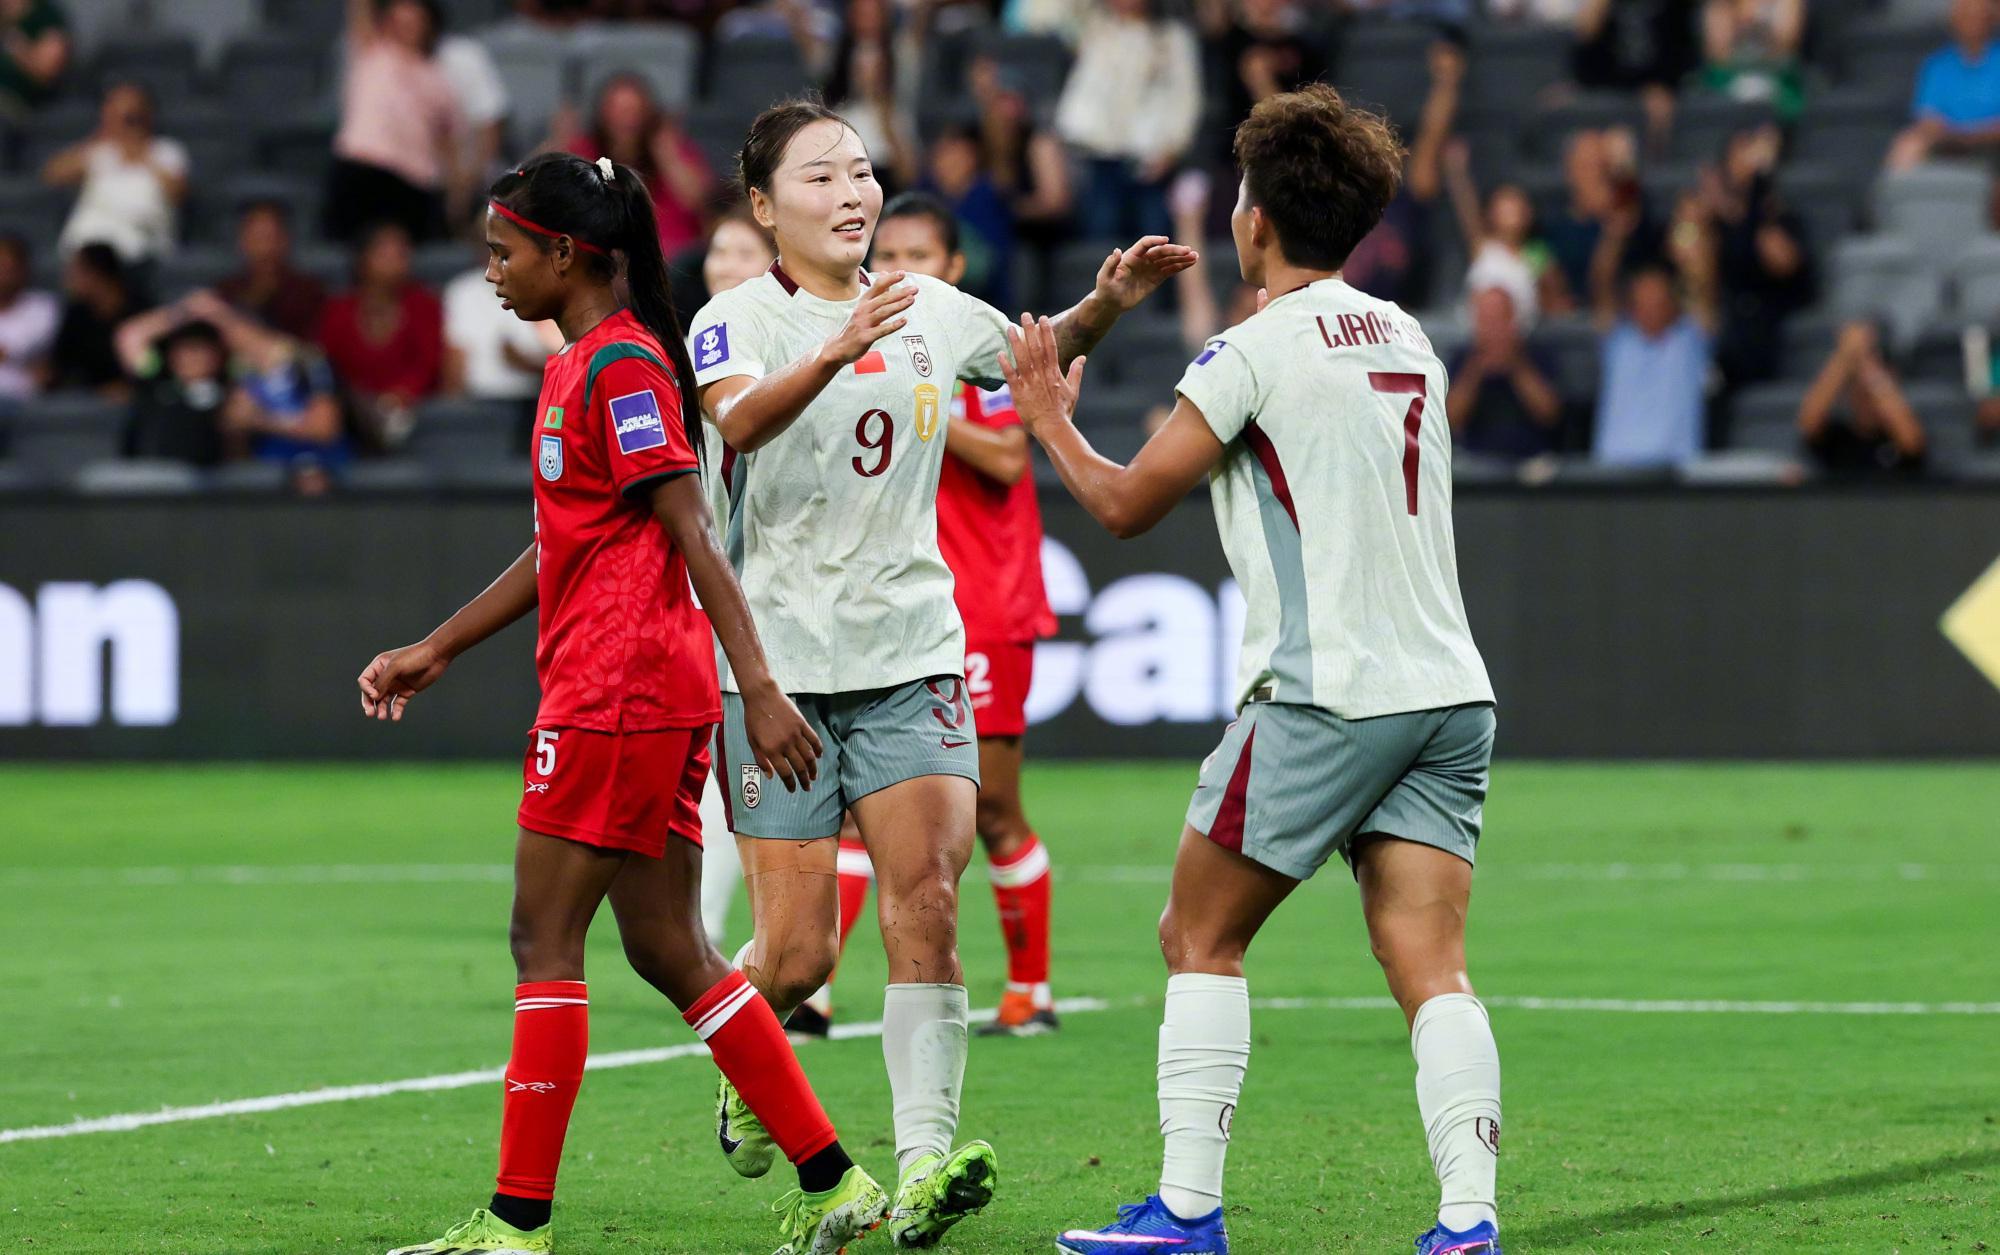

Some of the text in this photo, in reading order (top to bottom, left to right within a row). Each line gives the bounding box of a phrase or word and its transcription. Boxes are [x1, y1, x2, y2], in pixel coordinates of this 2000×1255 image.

[851, 408, 894, 478] 9
[1367, 371, 1427, 516] 7
[925, 678, 966, 729] 9
[536, 729, 559, 776] 5
